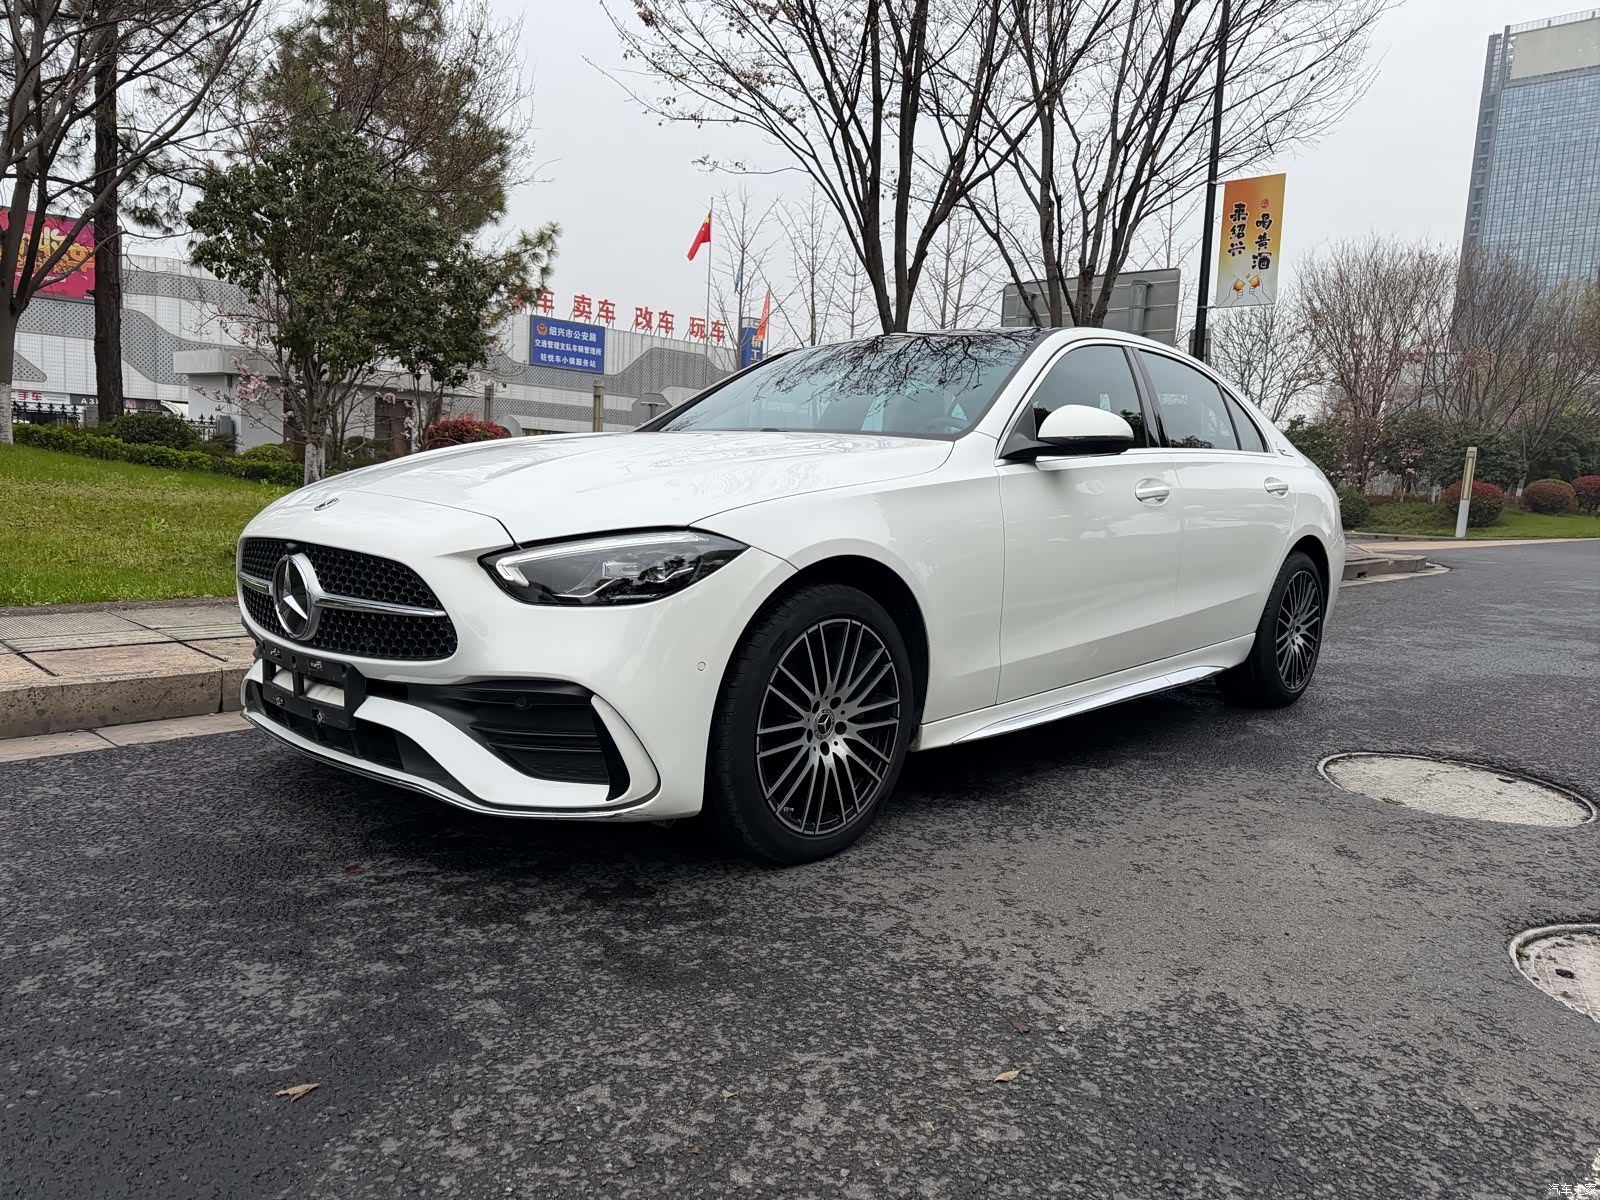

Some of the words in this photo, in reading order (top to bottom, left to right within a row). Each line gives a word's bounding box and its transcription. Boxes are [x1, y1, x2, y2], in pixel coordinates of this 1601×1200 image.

[1252, 212, 1273, 270] 喝黄酒
[573, 294, 616, 323] 卖车
[635, 306, 674, 334] 改车
[689, 316, 725, 342] 玩车
[534, 339, 602, 356] 交通管理支队车辆管理所
[548, 326, 597, 343] 绍兴市公安局
